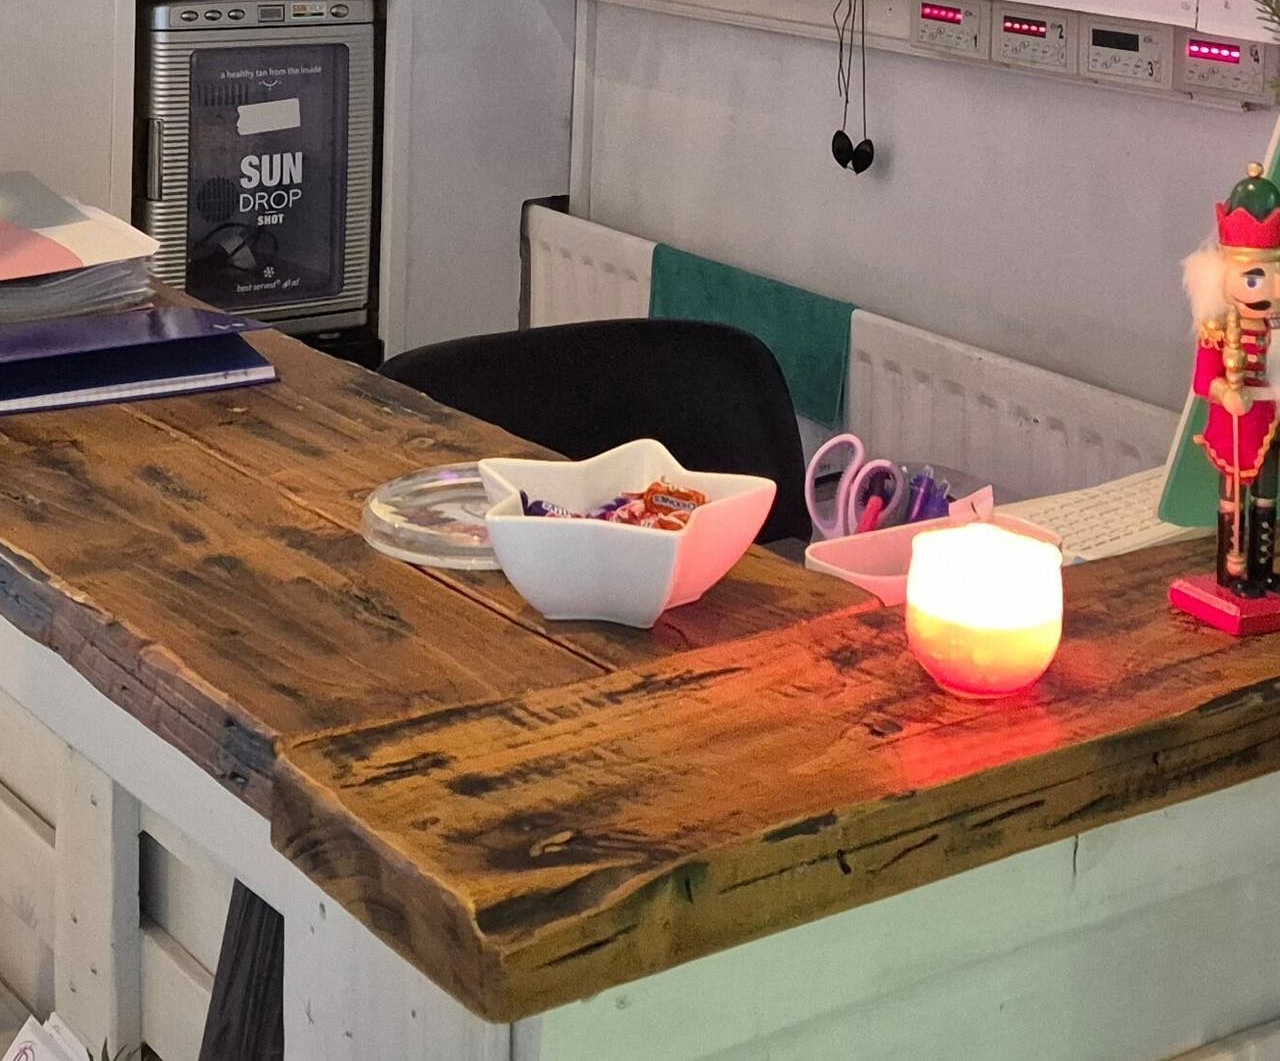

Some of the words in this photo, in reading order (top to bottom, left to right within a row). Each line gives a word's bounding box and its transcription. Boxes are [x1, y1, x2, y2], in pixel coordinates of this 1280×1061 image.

[239, 151, 303, 189] SUN
[238, 188, 303, 213] DROP
[257, 213, 286, 226] SHOT
